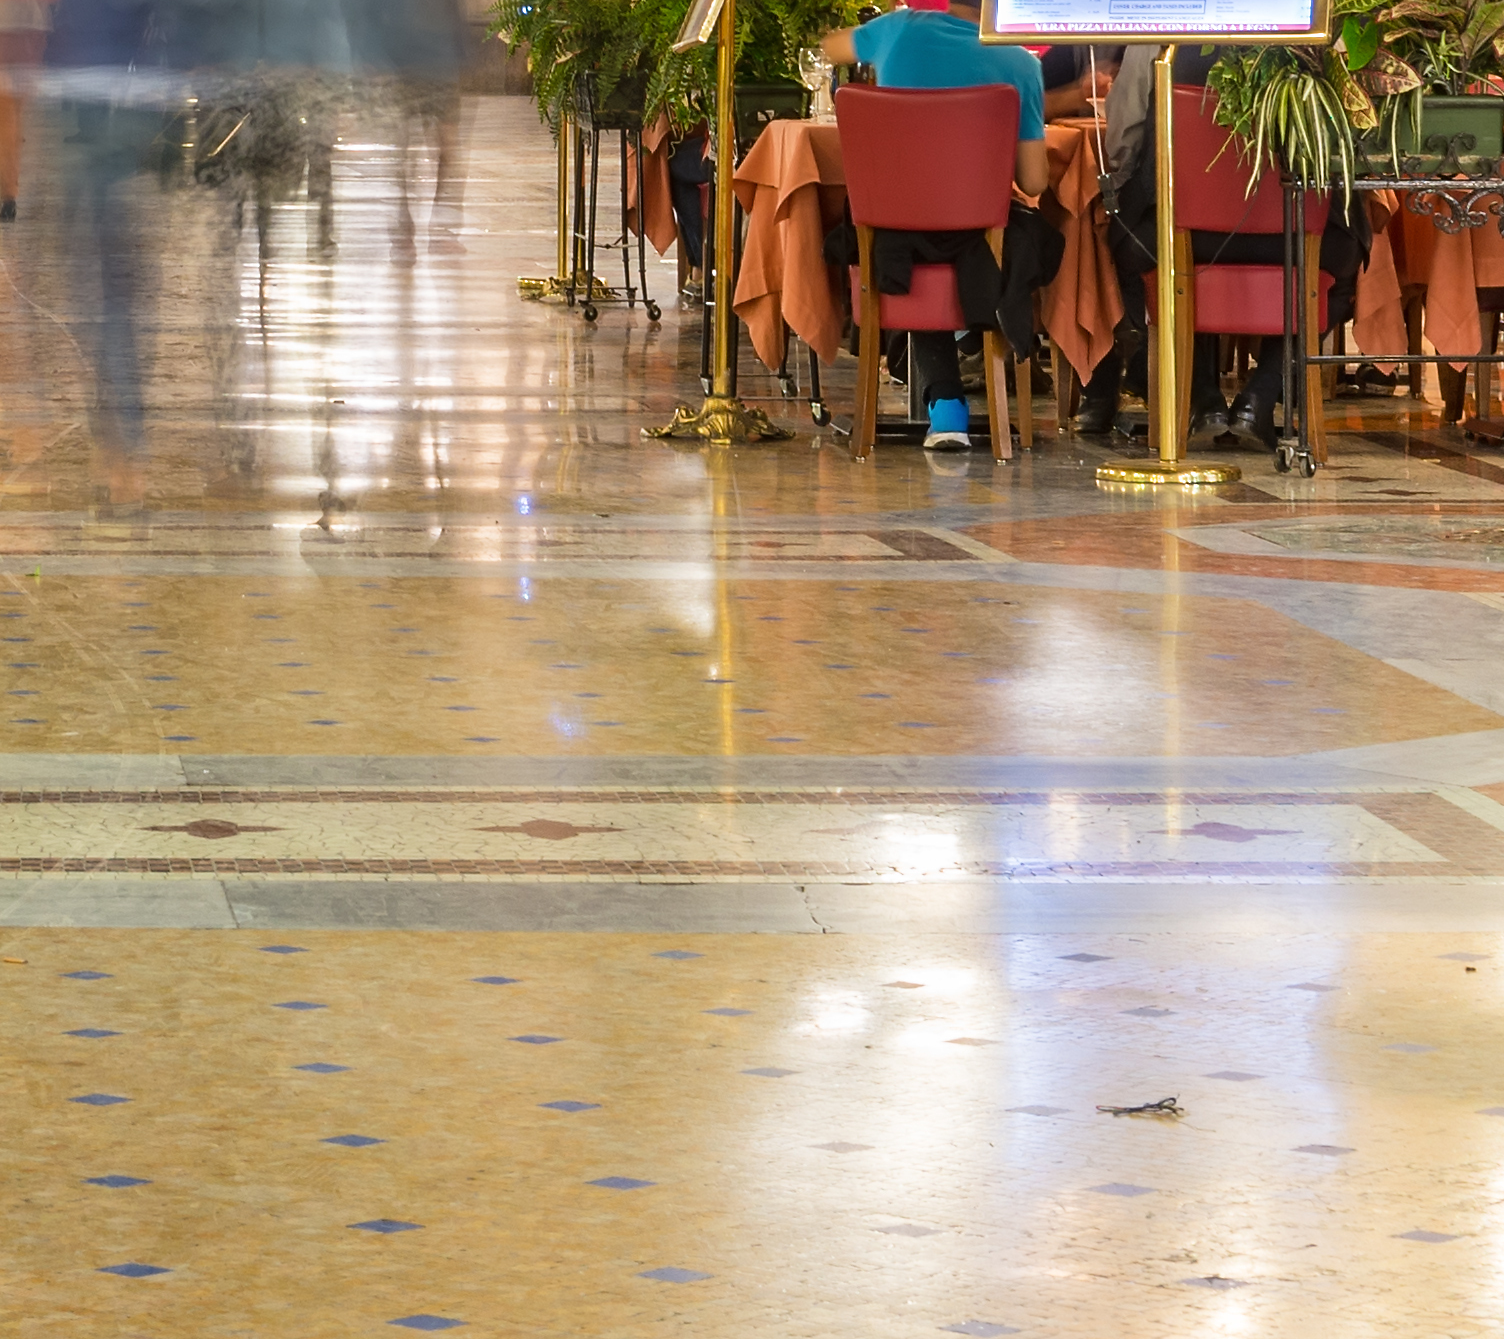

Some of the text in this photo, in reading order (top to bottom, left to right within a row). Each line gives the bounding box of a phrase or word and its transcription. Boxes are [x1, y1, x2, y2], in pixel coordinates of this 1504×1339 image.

[1034, 22, 1066, 32] VERA
[1067, 22, 1102, 32] PIZZA
[1102, 22, 1158, 32] ITALIANA
[1158, 23, 1184, 32] CON
[1186, 23, 1229, 32] FORNO
[1239, 23, 1279, 31] LEGNA
